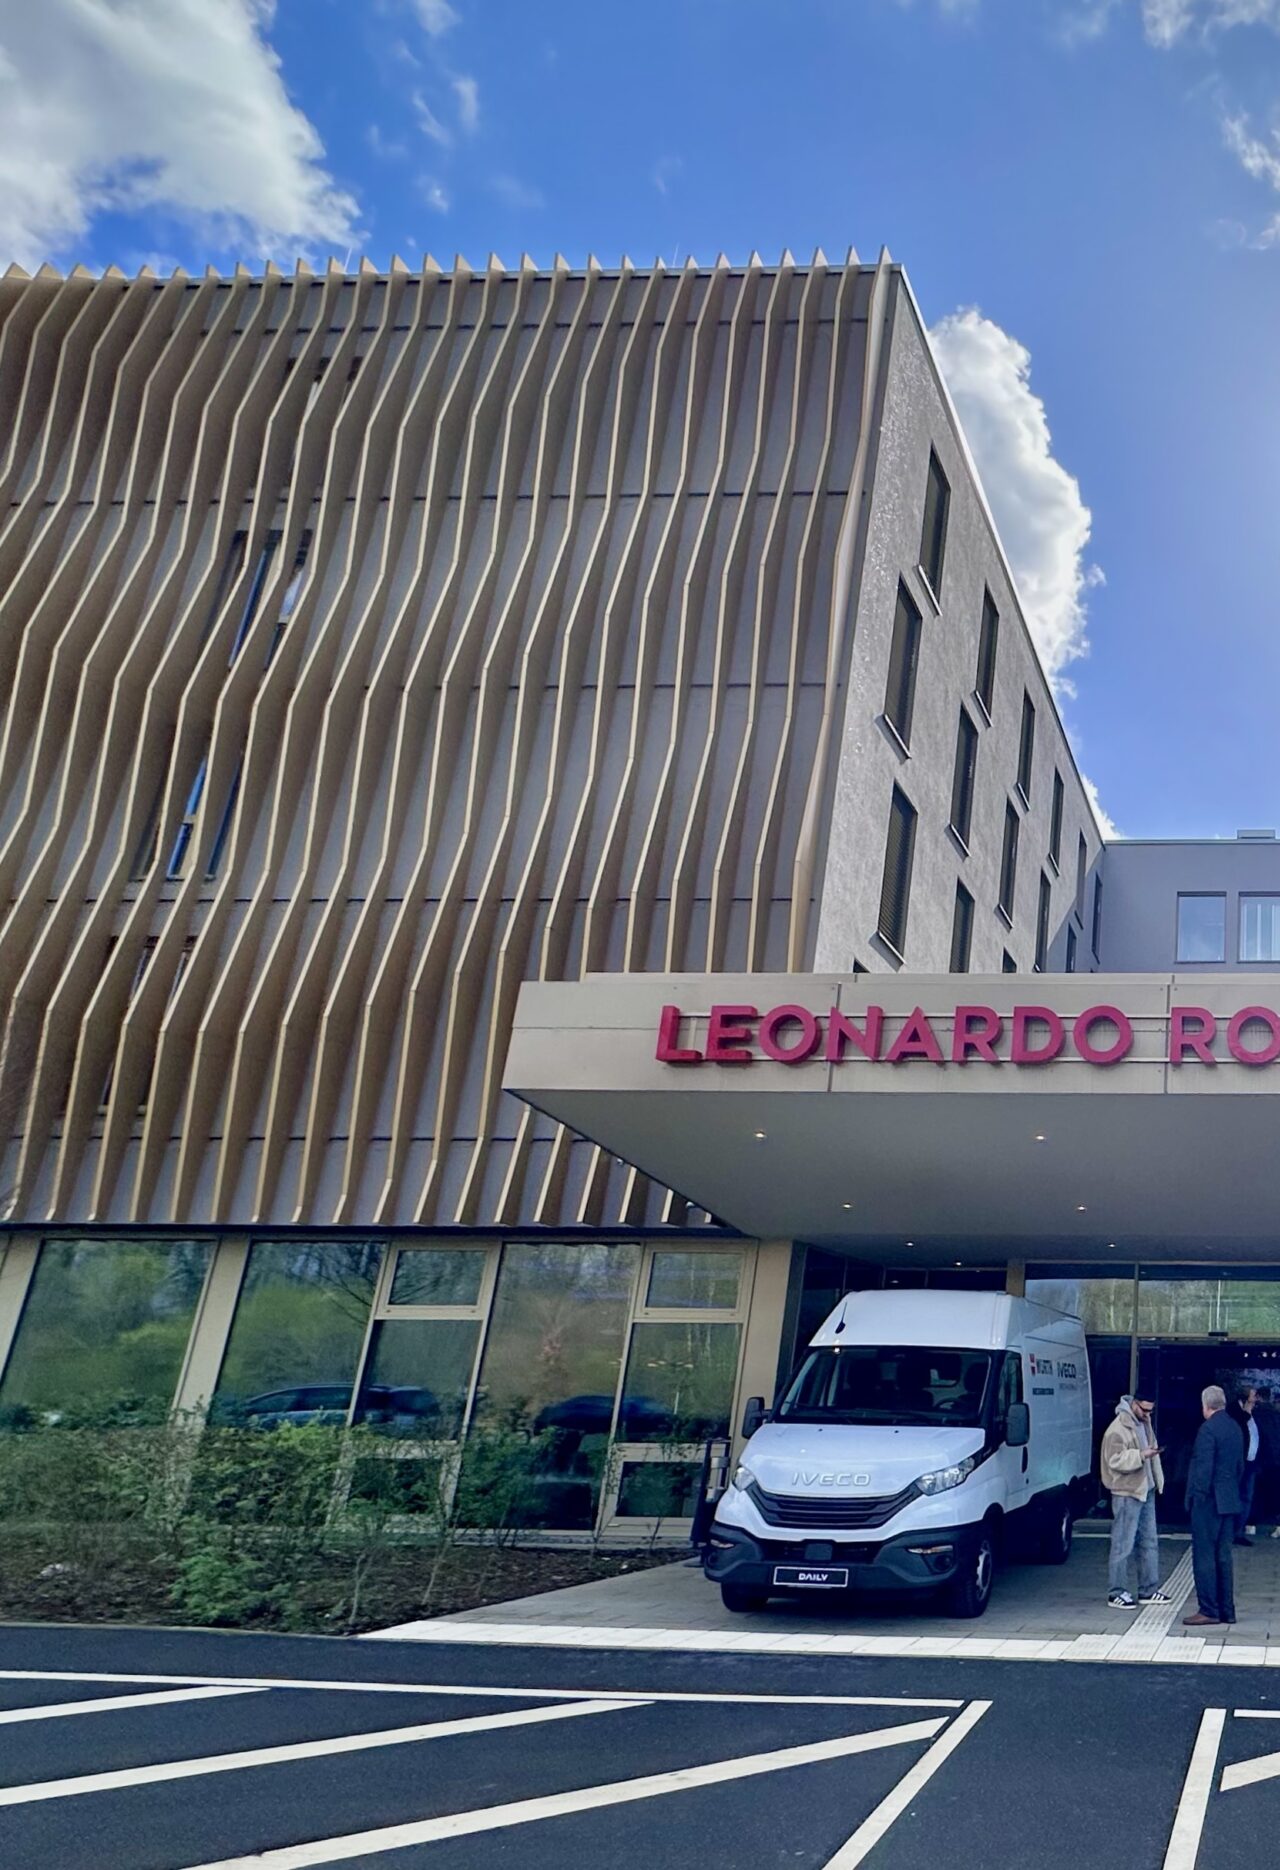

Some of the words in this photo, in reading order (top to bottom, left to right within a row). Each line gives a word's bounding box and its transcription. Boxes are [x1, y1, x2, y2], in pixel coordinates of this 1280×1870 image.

[656, 1004, 1134, 1065] LEONARDO
[791, 1472, 871, 1487] IVECO
[798, 1572, 829, 1582] DAILY
